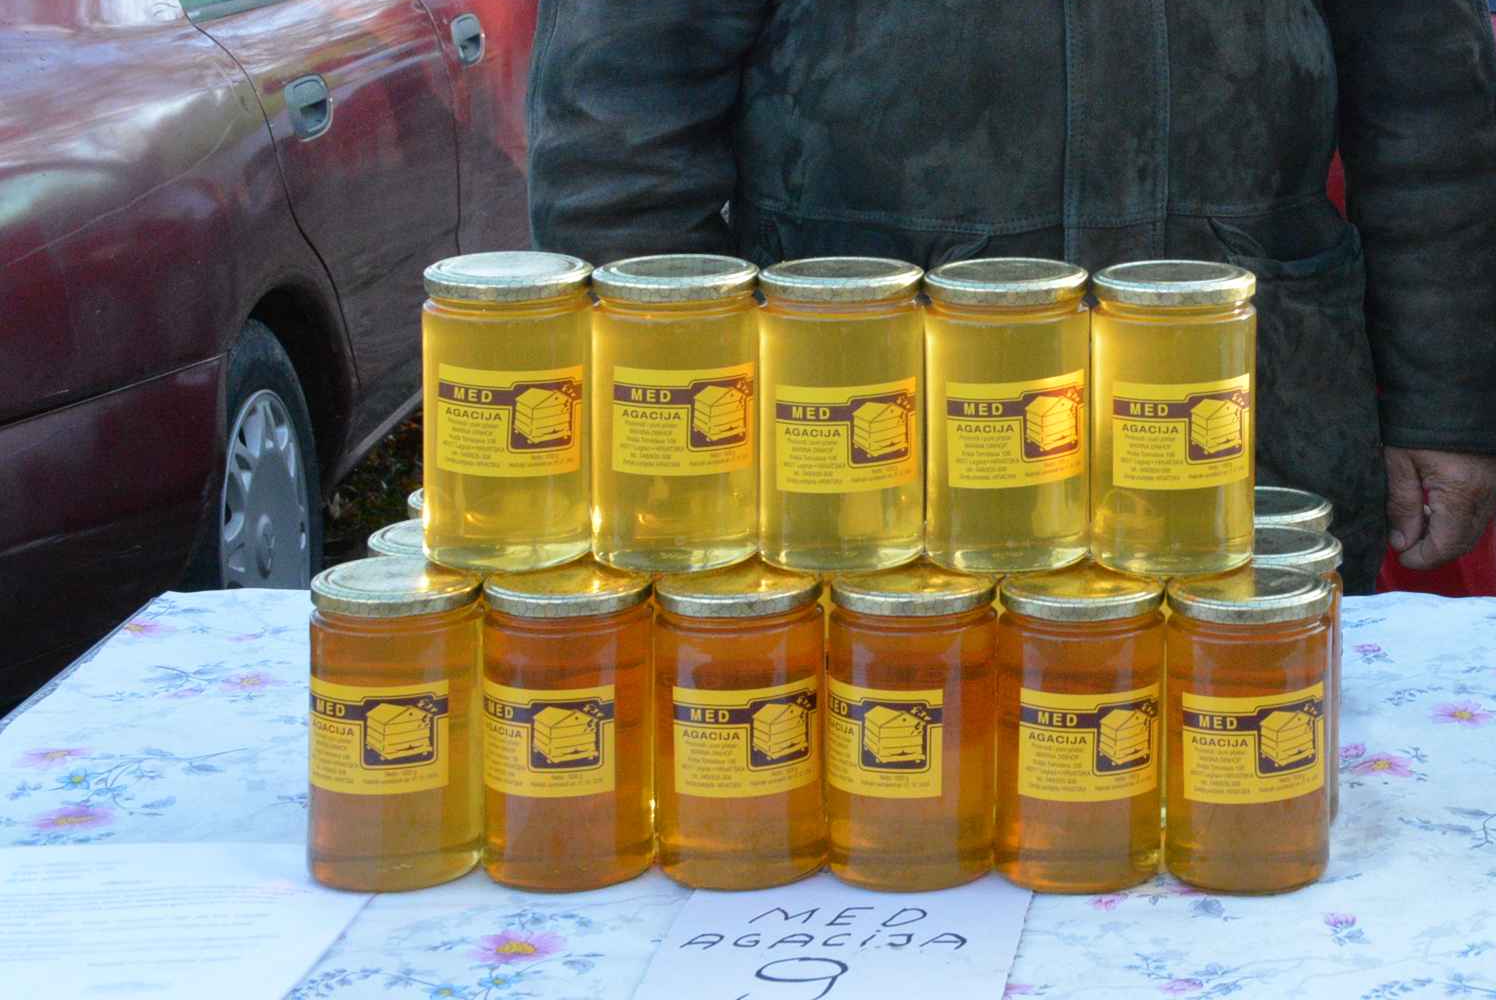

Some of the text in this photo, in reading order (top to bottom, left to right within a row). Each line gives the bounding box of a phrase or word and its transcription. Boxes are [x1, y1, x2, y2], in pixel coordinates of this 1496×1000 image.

[452, 386, 494, 403] MED
[631, 388, 673, 403] MED
[445, 407, 503, 421] AGACIJA
[621, 408, 682, 421] AGACIJA
[791, 405, 831, 421] MED
[963, 402, 1005, 417] MED
[1129, 402, 1169, 417] MED
[784, 427, 841, 439] AGACIJA
[955, 423, 1016, 435] AGACIJA
[1121, 423, 1179, 435] AGACIJA
[316, 698, 345, 717] MED
[830, 698, 848, 715] ED
[690, 708, 731, 725] MED
[1037, 712, 1078, 727] MED
[1199, 714, 1238, 731] MED
[682, 728, 741, 743] AGACIJA
[1028, 731, 1088, 745] AGACIJA
[1191, 734, 1249, 749] AGACIJA
[748, 906, 928, 928] MED
